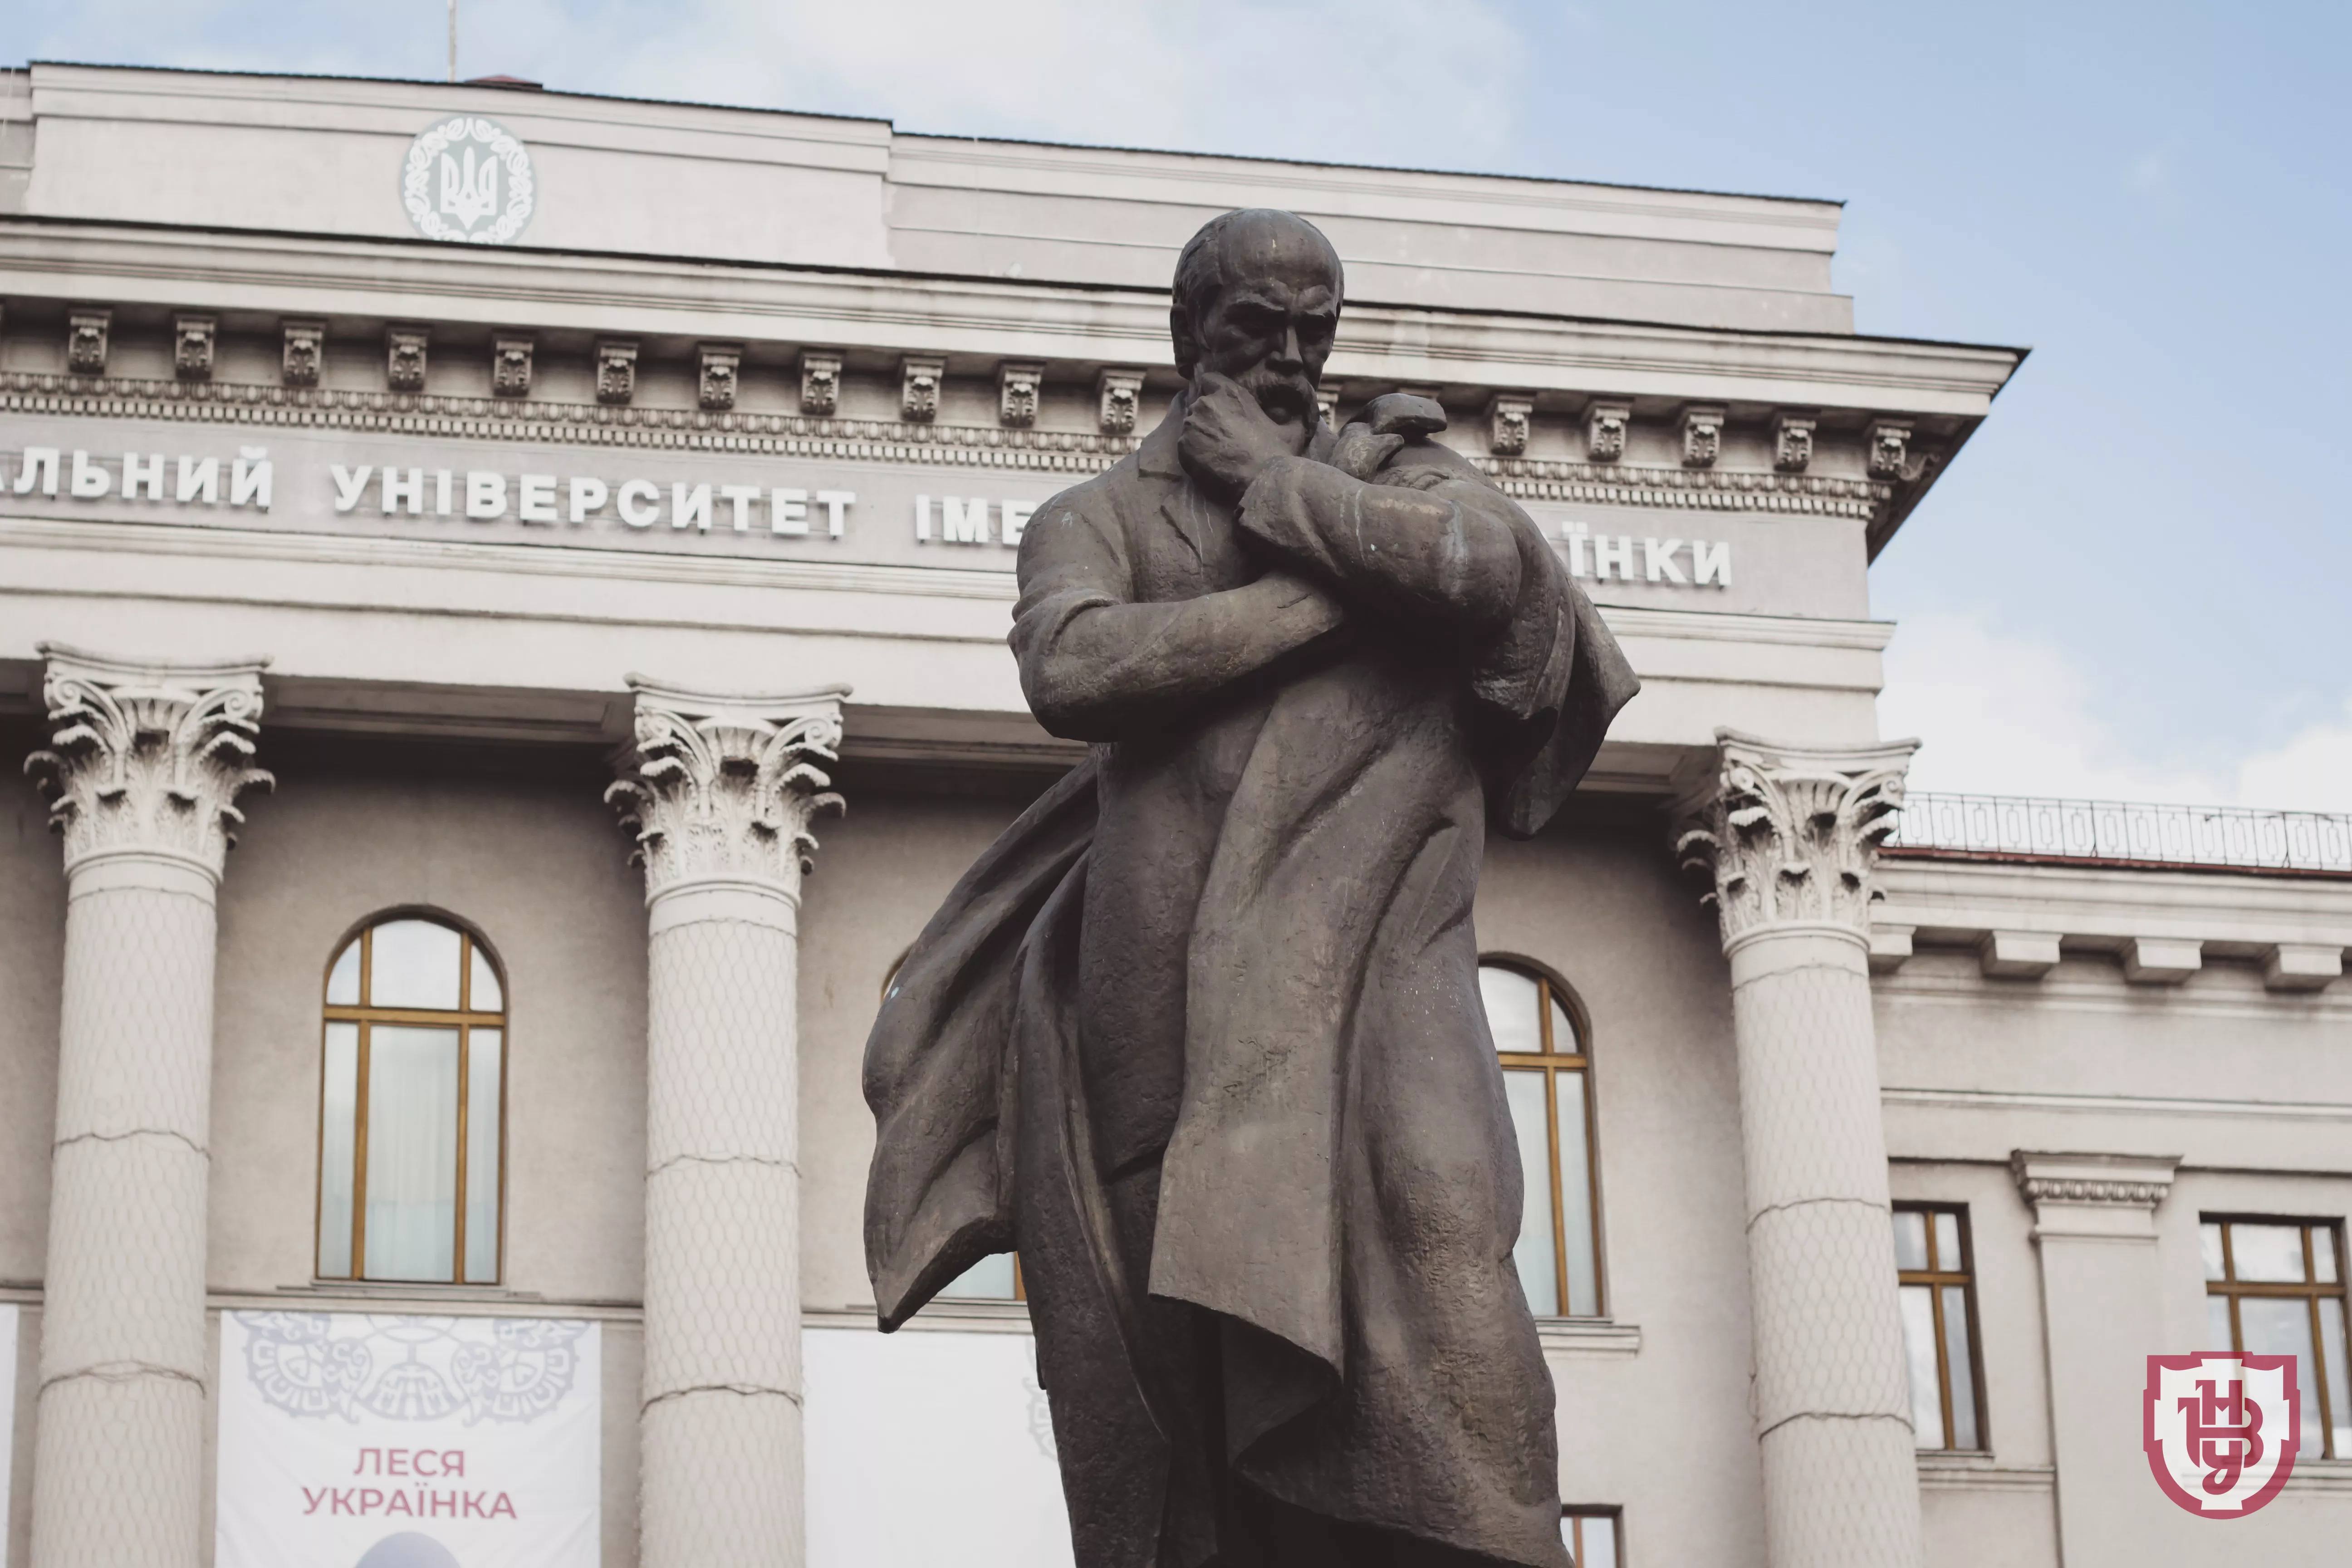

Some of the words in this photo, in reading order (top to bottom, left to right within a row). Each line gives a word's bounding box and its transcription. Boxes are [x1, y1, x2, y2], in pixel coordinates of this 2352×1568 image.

[0, 445, 271, 507] ЛЬНИЙ
[330, 464, 857, 536] УНІВЕРСИТЕТ
[1542, 520, 1732, 586] ЇНКИ
[353, 1448, 466, 1477] ЛЕСЯ
[301, 1483, 517, 1519] УКРАЇНКА
